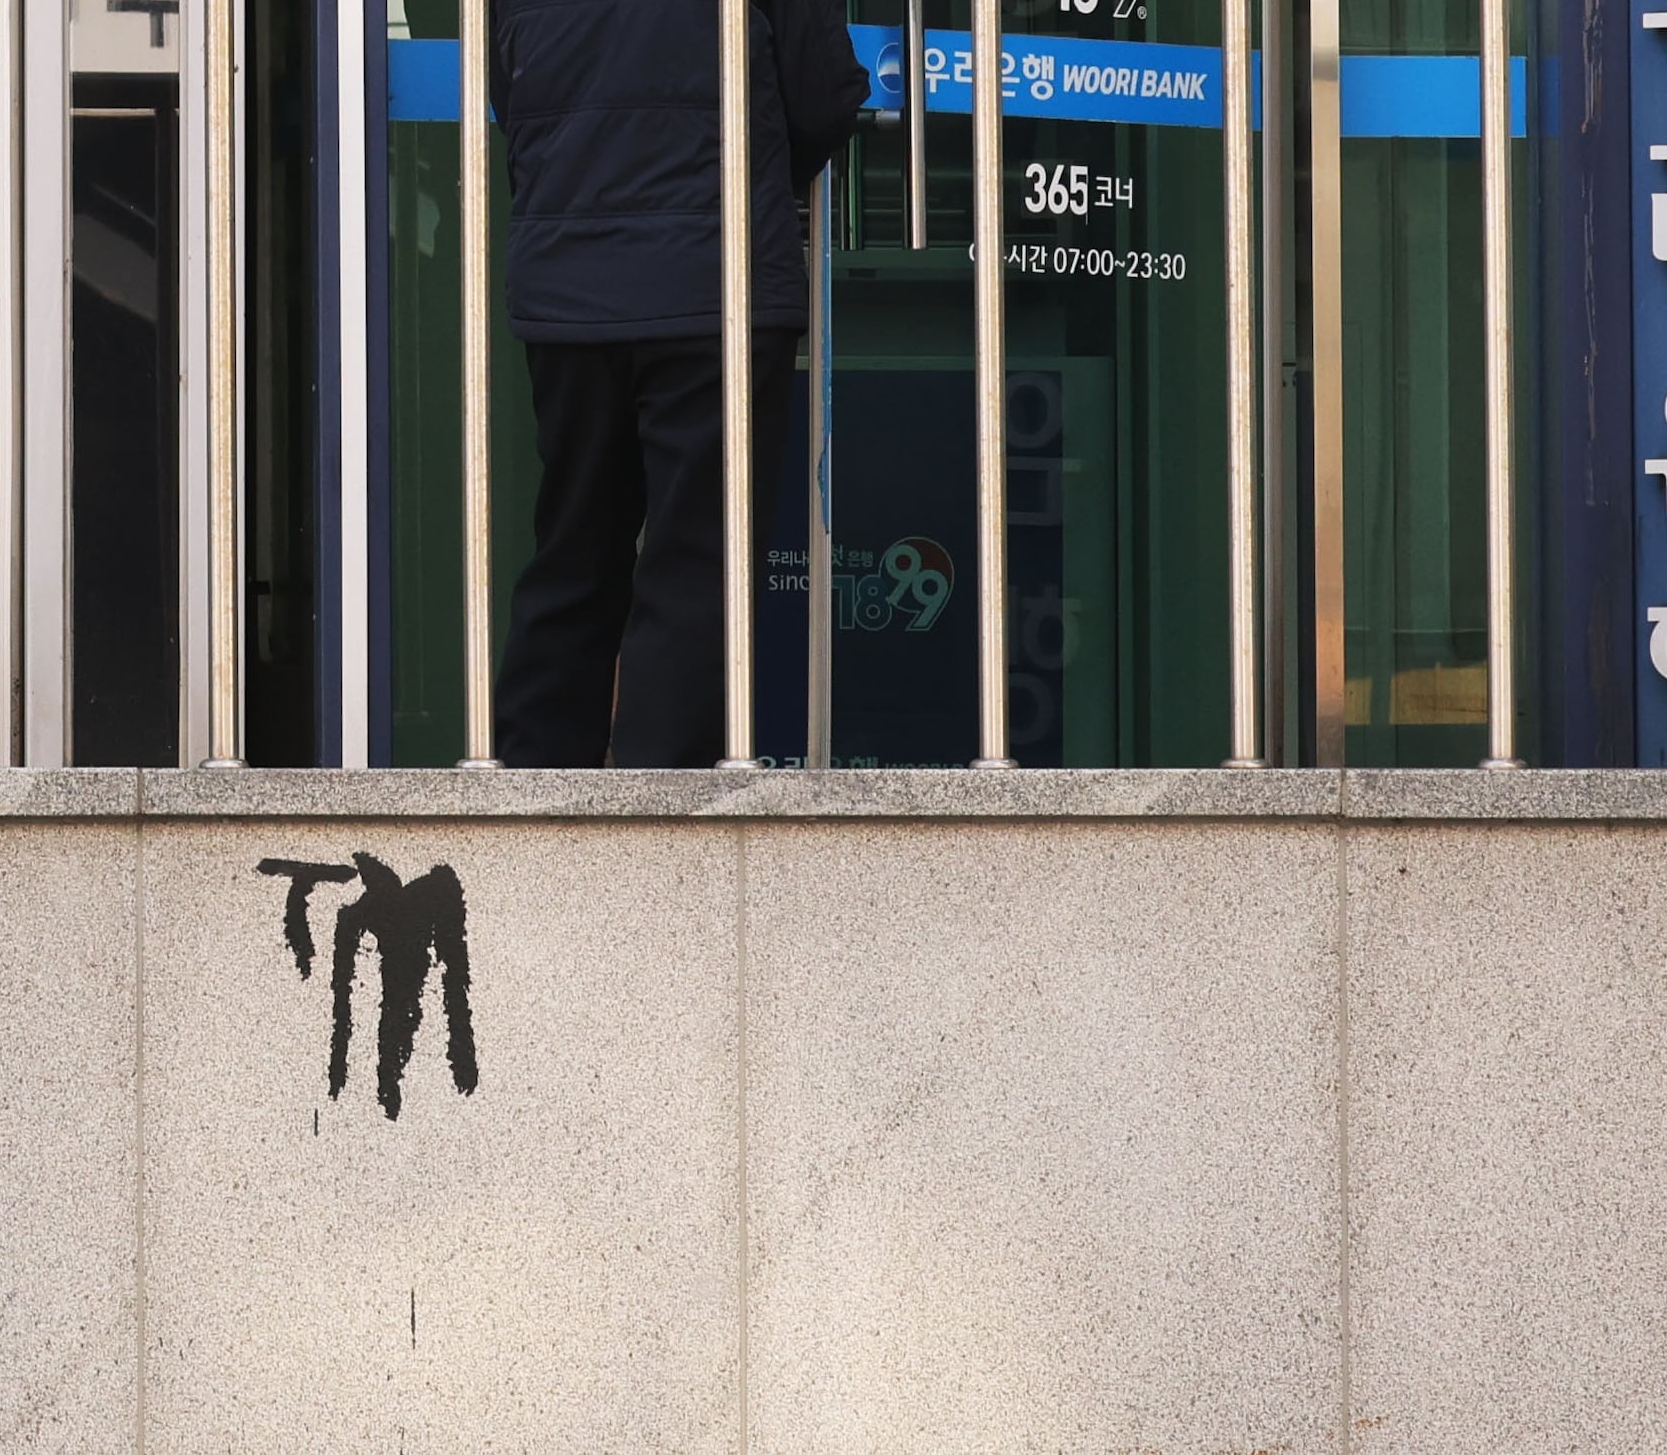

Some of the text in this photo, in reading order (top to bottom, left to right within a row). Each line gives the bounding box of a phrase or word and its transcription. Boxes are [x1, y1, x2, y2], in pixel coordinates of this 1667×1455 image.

[1063, 65, 1138, 96] WOORI
[1140, 71, 1207, 101] BANK
[1024, 163, 1133, 215] 365 코너
[1053, 247, 1186, 280] 07:00~23:30
[767, 550, 809, 567] 우리나
[769, 574, 809, 591] sinc
